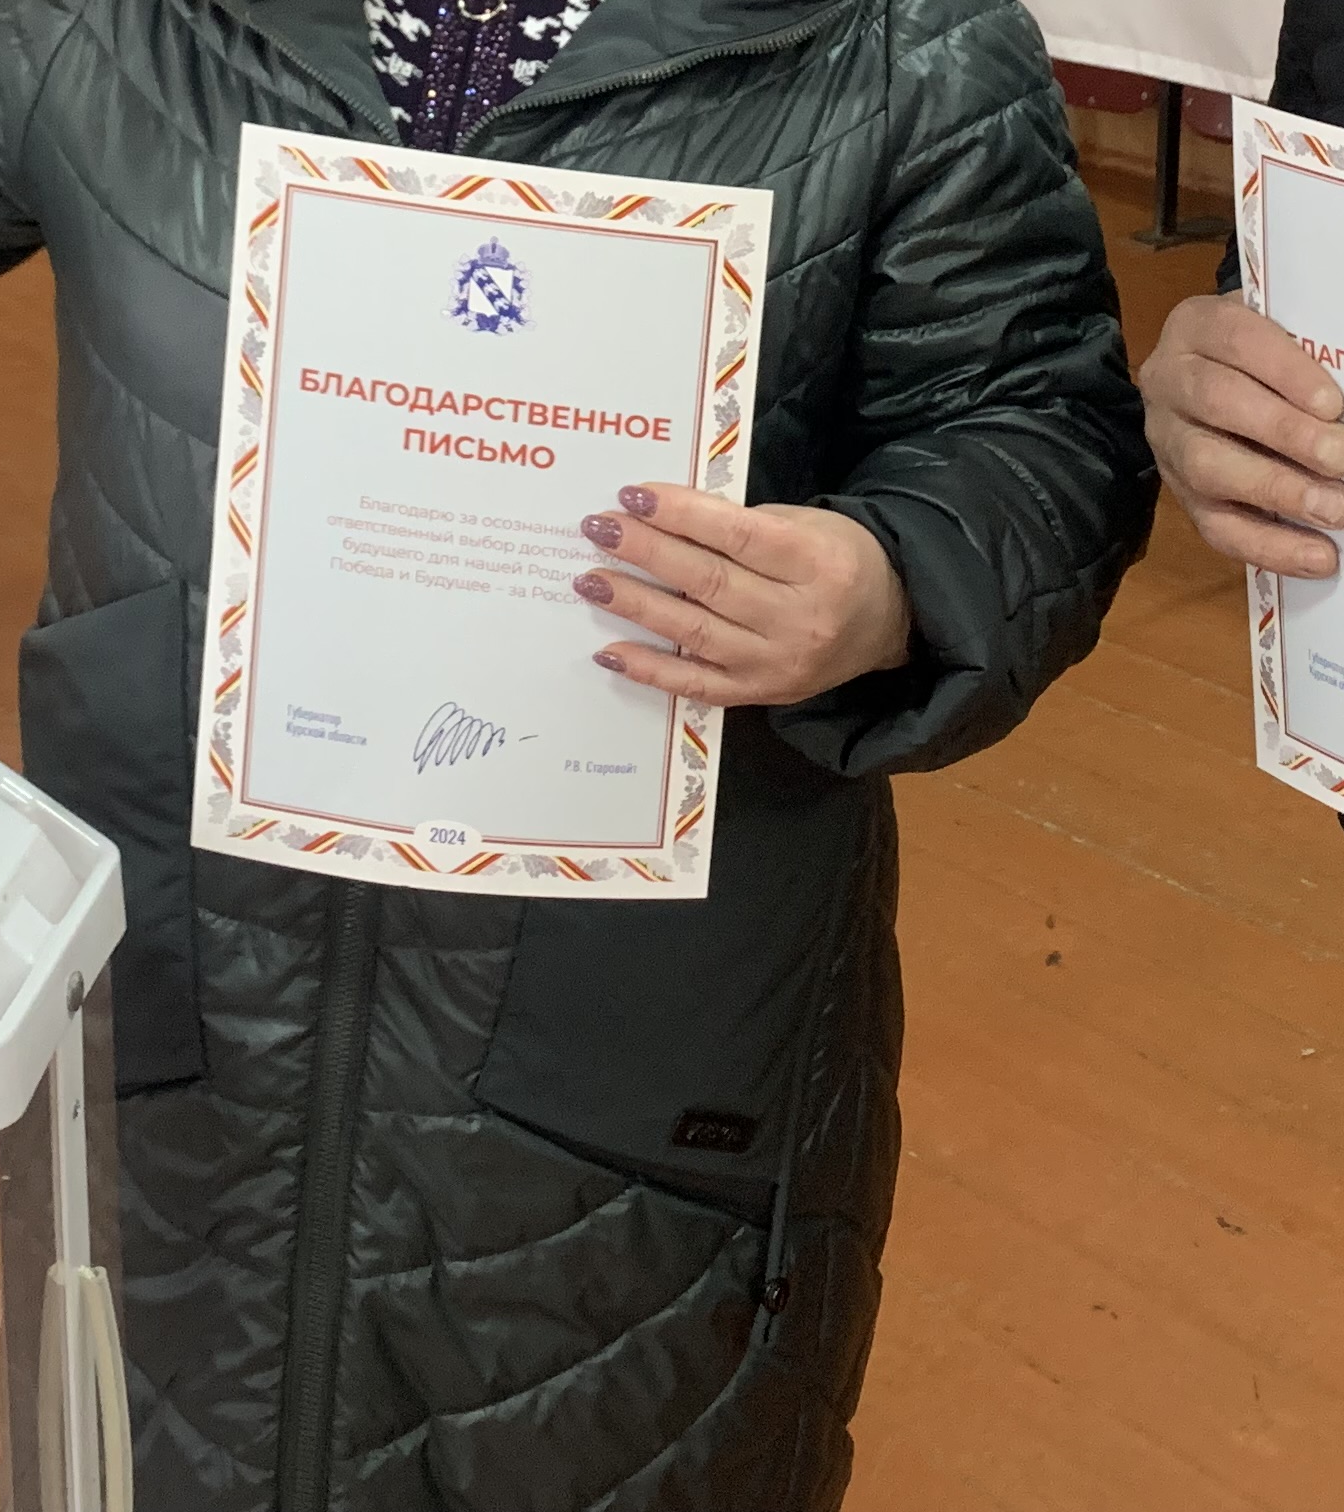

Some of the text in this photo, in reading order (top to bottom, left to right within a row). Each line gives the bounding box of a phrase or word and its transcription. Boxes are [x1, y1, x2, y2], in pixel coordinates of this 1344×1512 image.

[299, 367, 672, 442] БЛАГОДАРСТВЕННОЕ
[402, 427, 556, 470] ПИСЬМО
[326, 515, 454, 544] ответственный
[459, 535, 516, 554] выбор
[359, 495, 585, 539] Благодарю за осознанны
[330, 556, 394, 579] Победа
[399, 570, 410, 580] и
[415, 570, 491, 593] Будущее
[508, 585, 527, 598] за
[342, 537, 425, 561] будущего
[427, 553, 460, 567] для
[465, 557, 523, 575] нашей
[429, 827, 467, 846] 2024
